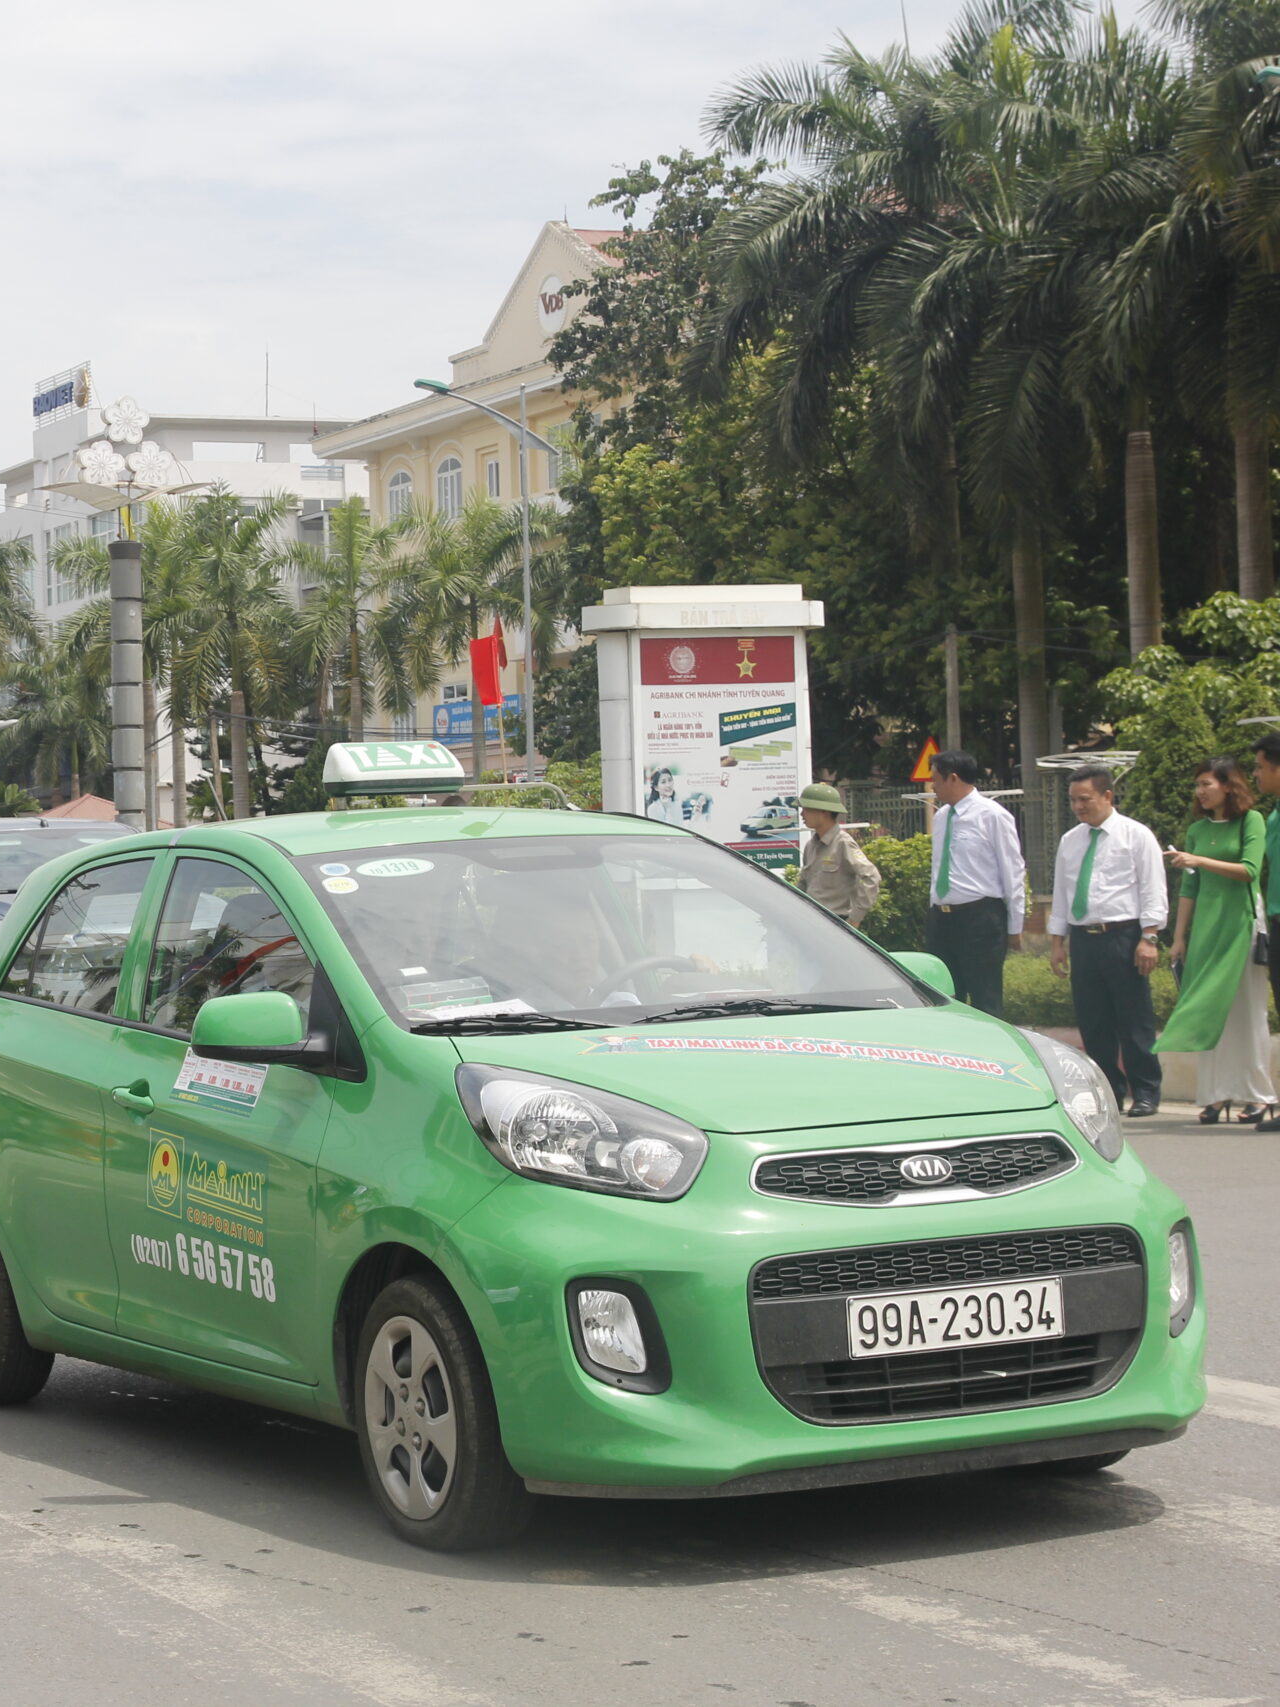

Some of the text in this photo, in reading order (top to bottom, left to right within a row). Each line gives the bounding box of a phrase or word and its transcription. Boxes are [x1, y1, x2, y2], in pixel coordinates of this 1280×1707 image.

[540, 292, 564, 314] VDB
[650, 691, 684, 700] AGRIBANK
[685, 691, 697, 699] CHI
[697, 689, 721, 698] NHÁNH
[739, 687, 760, 697] TUYÊN
[761, 689, 785, 698] QUANG
[662, 711, 704, 719] AGRIBANK
[723, 709, 761, 723] KHUYẾN
[646, 1039, 1003, 1075] TAXI MAI LINH ĐÃ CÓ MẶT TẠI TUYÊN QUANG
[907, 1158, 949, 1178] KIA
[186, 1207, 264, 1247] CORPORATION
[131, 1233, 172, 1271] (0207)
[857, 1285, 1056, 1350] 99A-230.34
